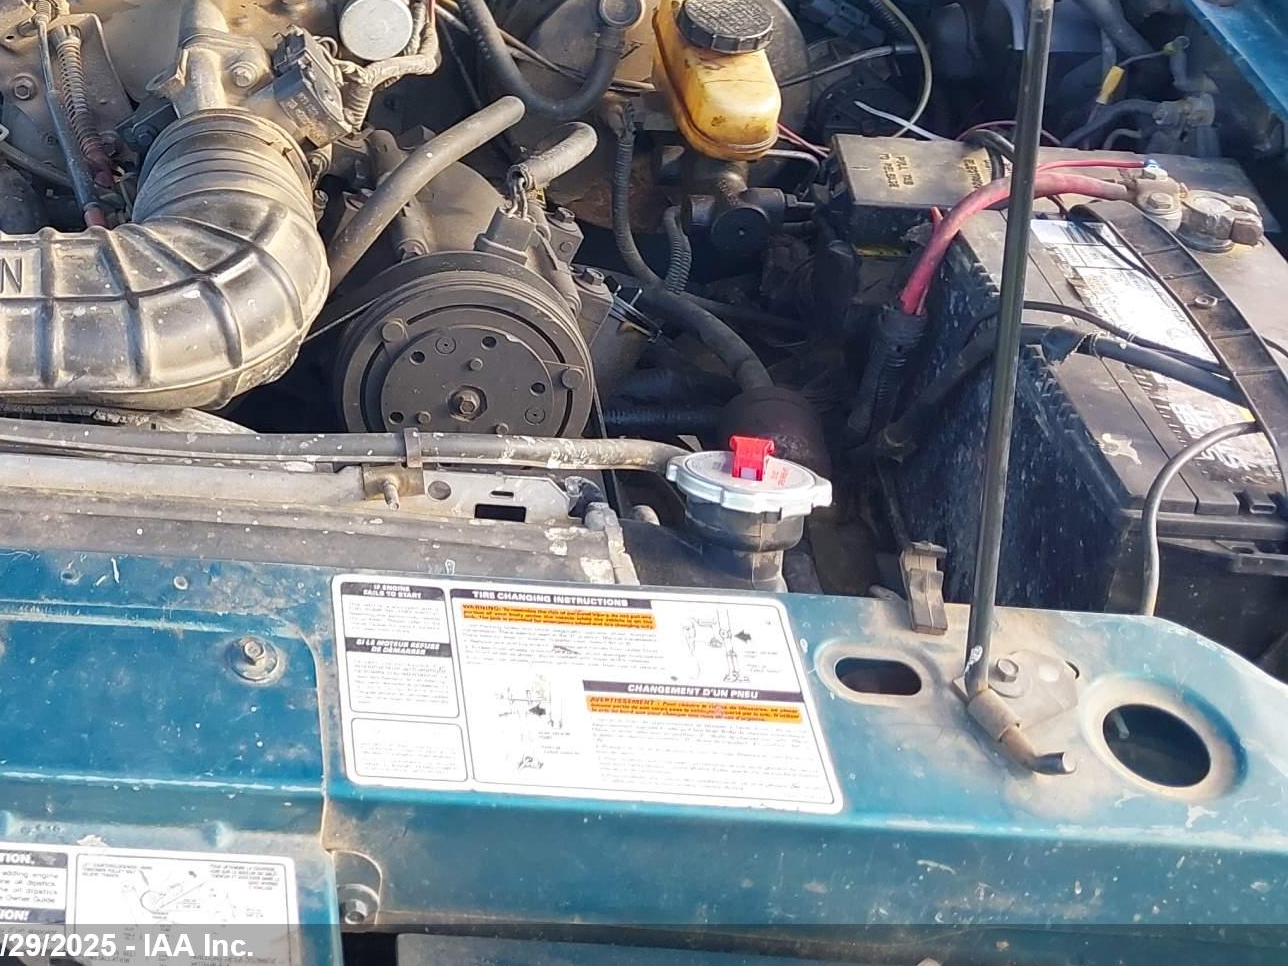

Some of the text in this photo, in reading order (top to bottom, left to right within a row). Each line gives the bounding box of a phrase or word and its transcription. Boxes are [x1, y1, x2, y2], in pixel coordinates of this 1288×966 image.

[472, 590, 629, 607] TIRE CHANGING INSTRUCTIONS
[376, 640, 410, 648] MOTEUR
[410, 642, 441, 650] REFUSE
[627, 684, 759, 699] CHANGEMENT D'UN PNEU
[32, 872, 59, 881] engine
